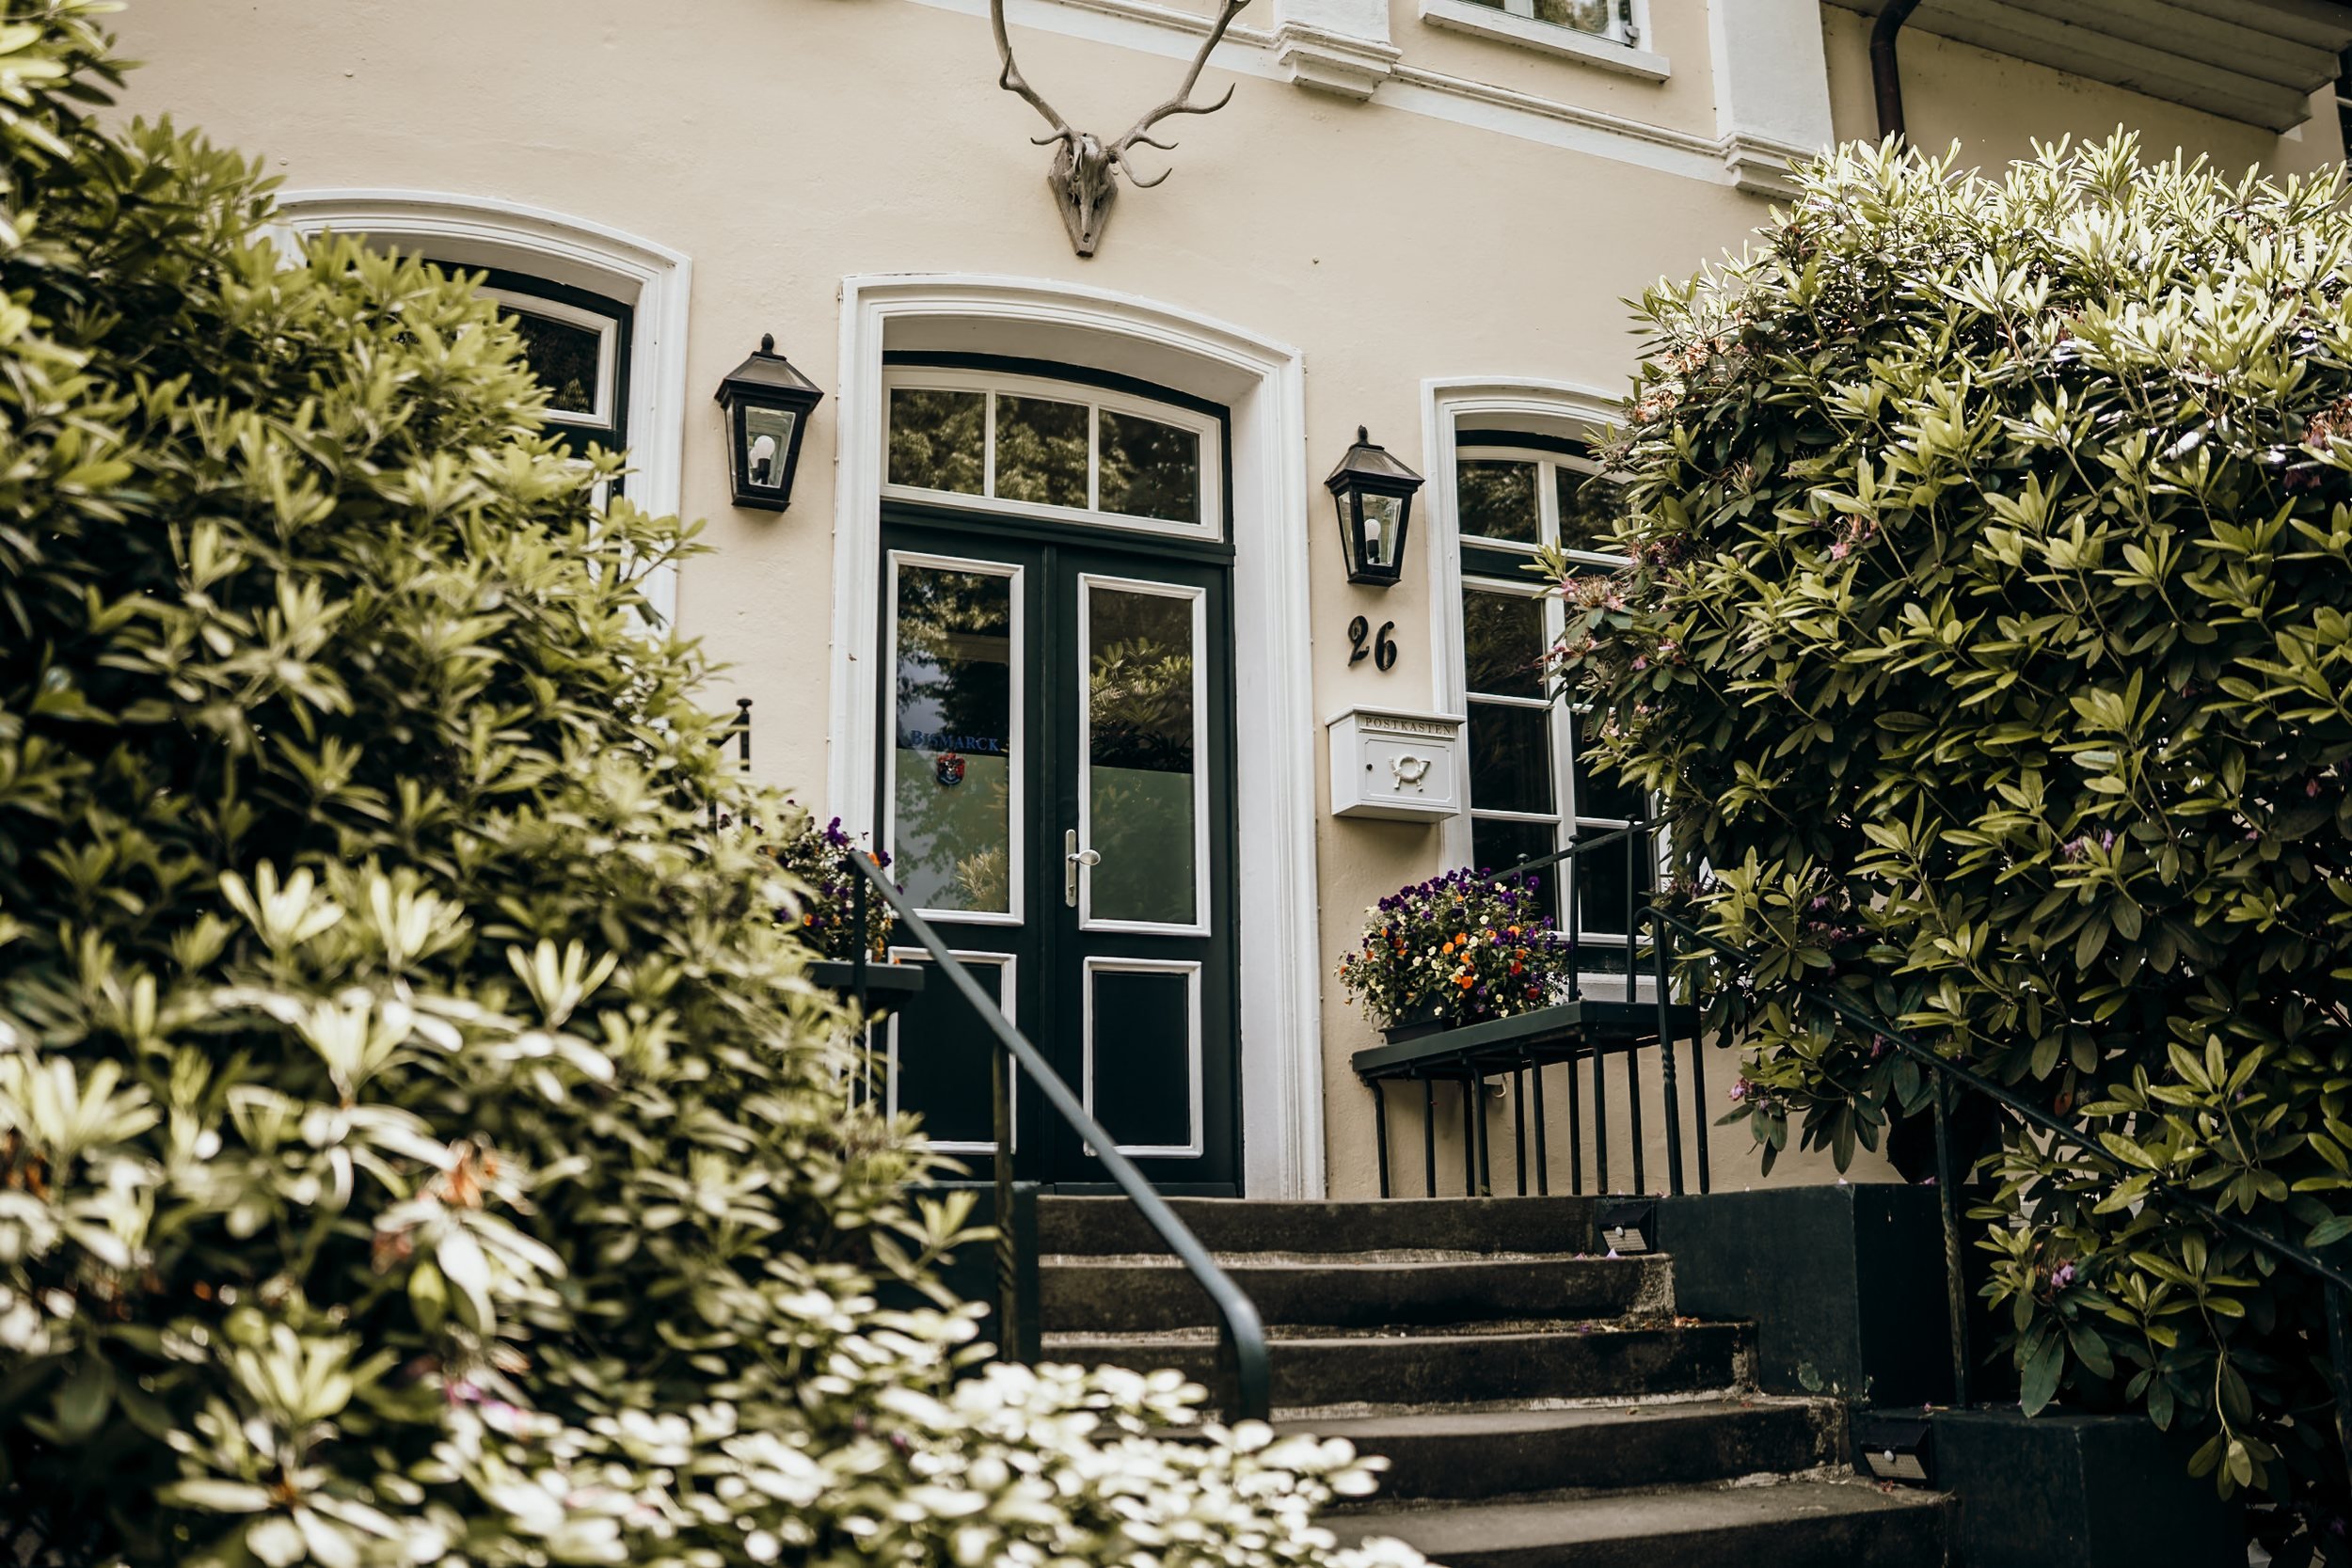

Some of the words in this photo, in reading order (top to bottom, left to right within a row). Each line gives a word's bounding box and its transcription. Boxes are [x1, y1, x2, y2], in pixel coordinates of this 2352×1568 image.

[1347, 615, 1397, 672] 26
[1365, 717, 1450, 735] POSTKASTEN
[911, 730, 999, 752] BISMARCK
